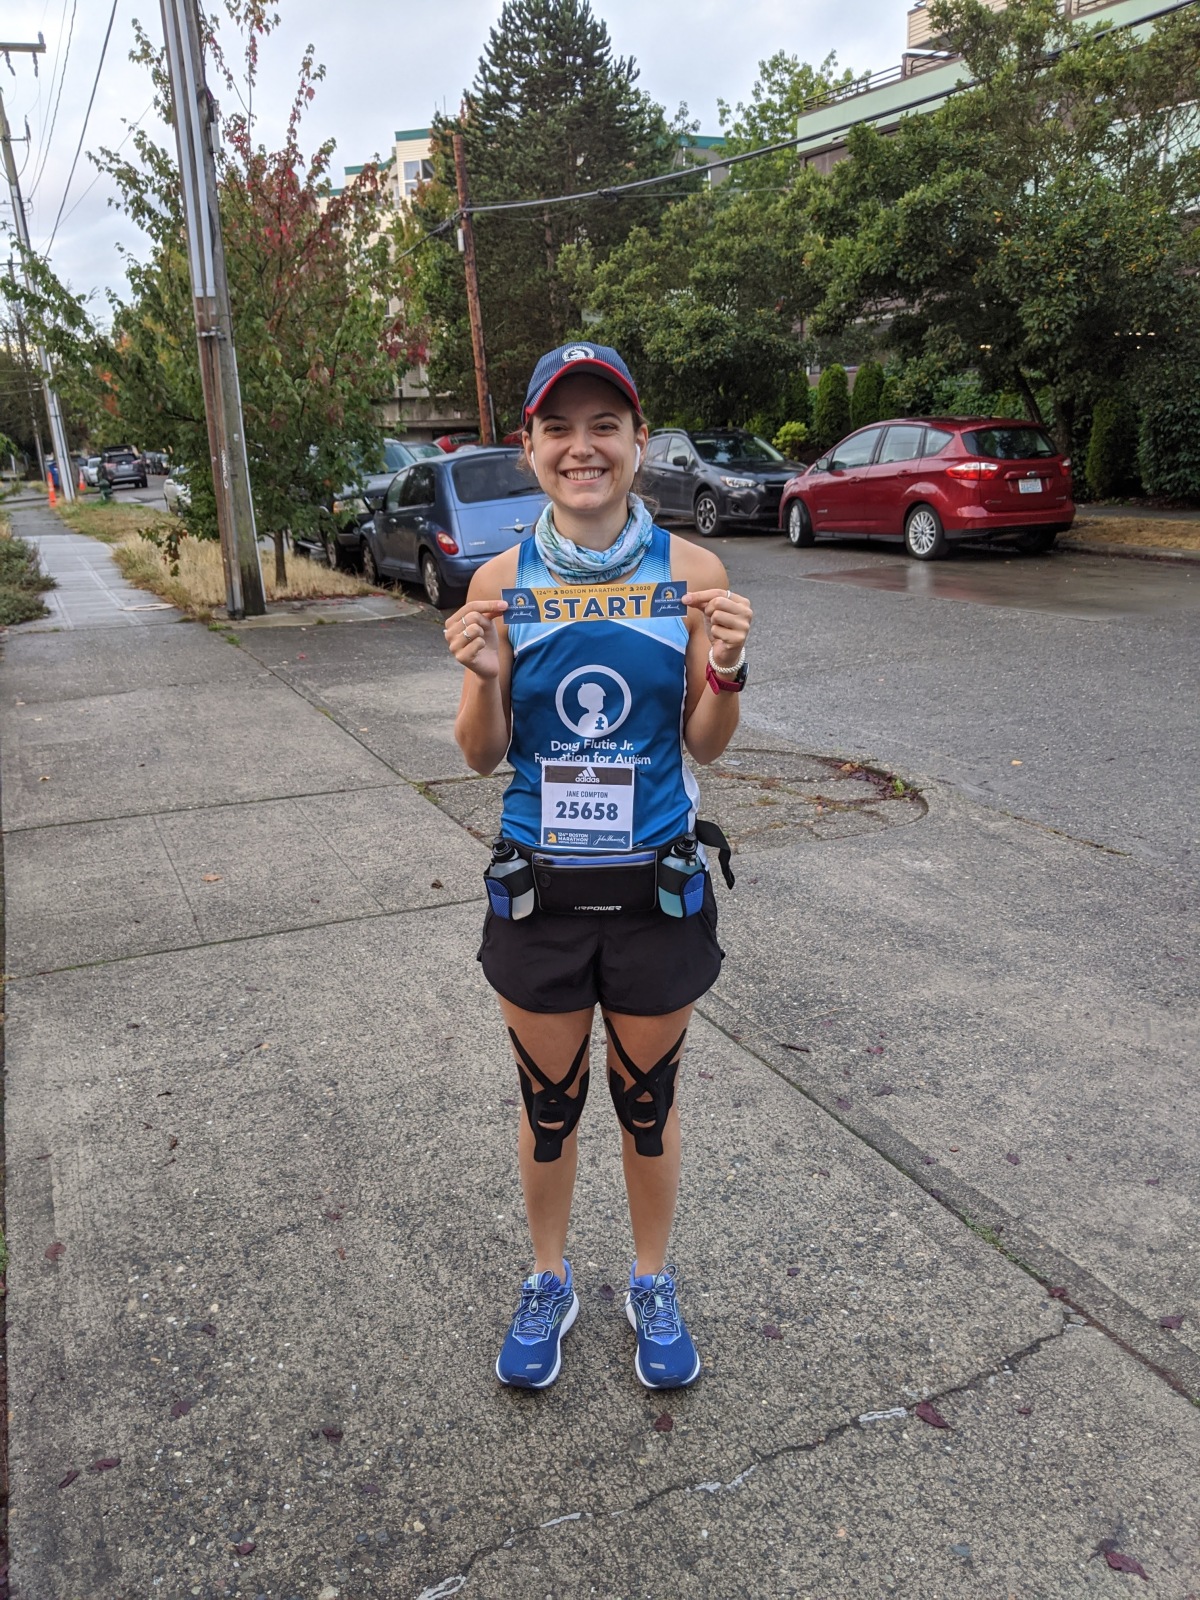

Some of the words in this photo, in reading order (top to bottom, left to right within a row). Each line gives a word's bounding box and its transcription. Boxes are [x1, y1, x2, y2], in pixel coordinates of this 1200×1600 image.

[543, 595, 647, 620] START
[550, 740, 581, 752] Doug
[583, 738, 618, 750] Flutie
[619, 739, 634, 751] Jr.
[593, 752, 612, 763] for
[614, 753, 652, 765] Autism
[575, 775, 601, 784] adidas
[566, 790, 580, 798] JANE
[580, 790, 609, 799] COMPTON
[555, 801, 619, 821] 25658
